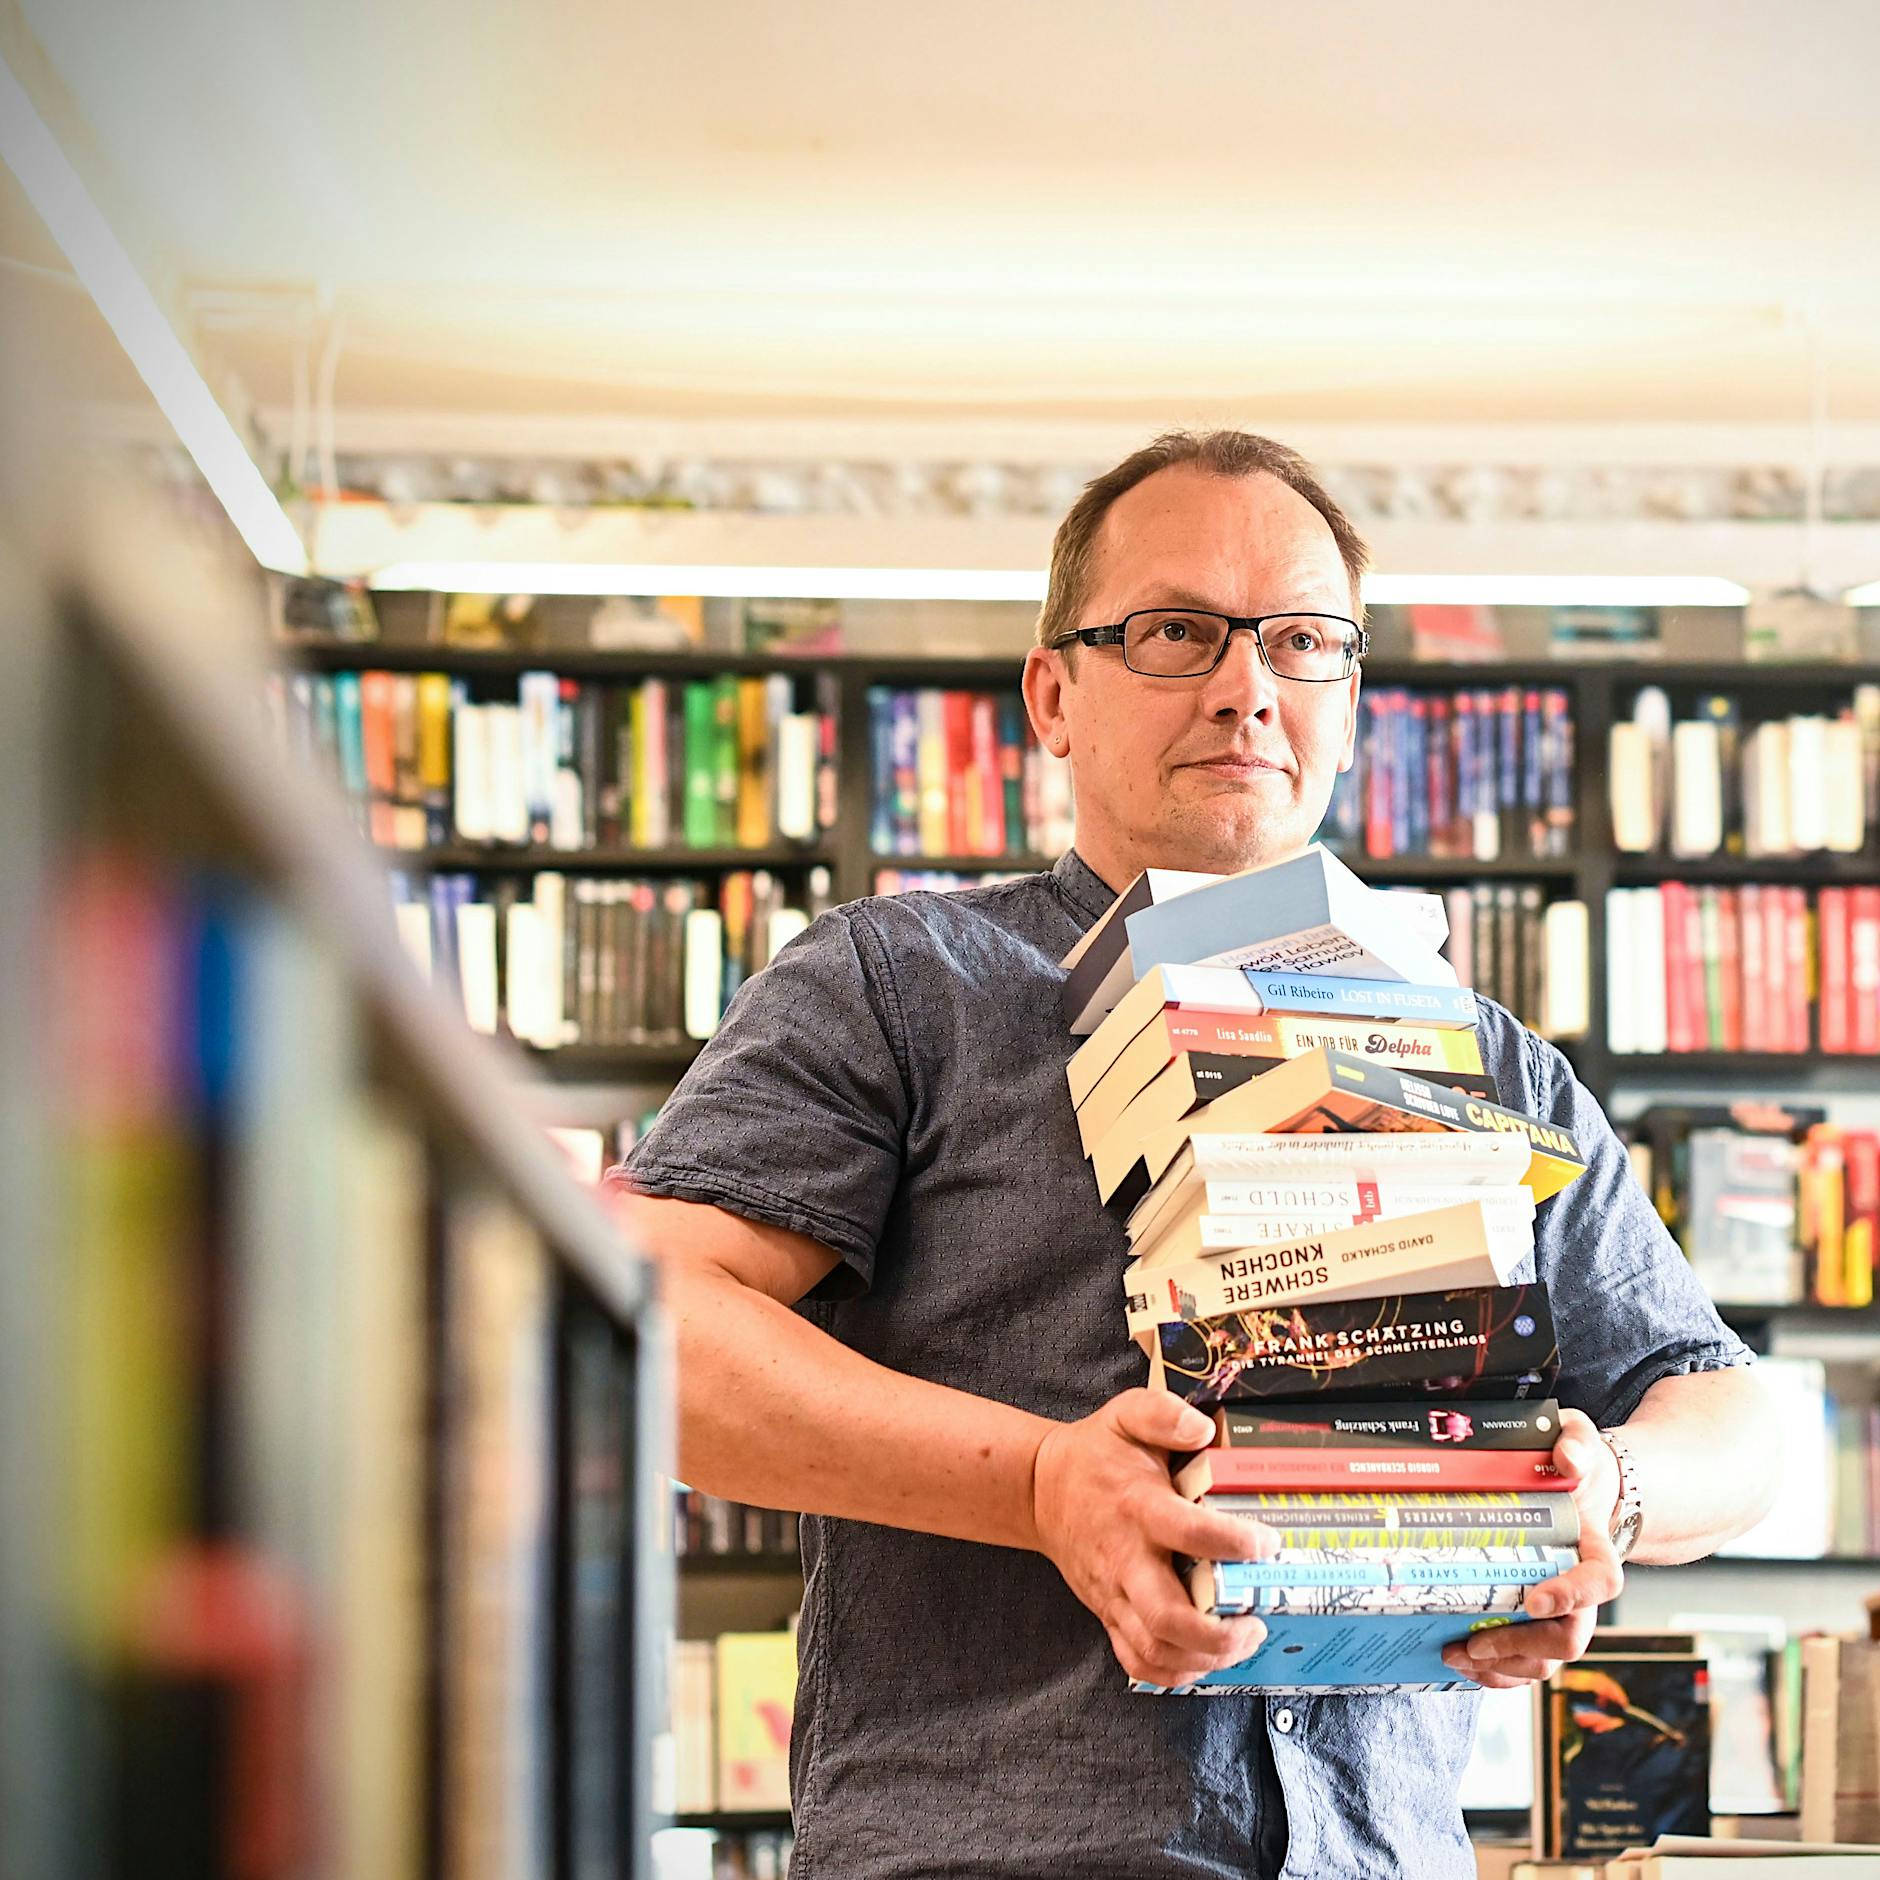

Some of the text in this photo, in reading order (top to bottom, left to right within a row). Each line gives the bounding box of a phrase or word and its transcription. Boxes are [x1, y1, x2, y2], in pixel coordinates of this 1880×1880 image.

[1283, 941, 1357, 966] Samuel
[1287, 935, 1348, 955] Leben
[1295, 947, 1365, 973] Hawley
[1268, 984, 1286, 997] Gil
[1291, 985, 1334, 1000] Ribeiro
[1340, 988, 1373, 1002] LOST
[1376, 991, 1391, 1004] IN
[1394, 993, 1442, 1007] FUSETA
[1216, 1028, 1236, 1041] Lisa
[1238, 1029, 1273, 1043] Sandlin
[1296, 1034, 1314, 1048] EIN
[1340, 1036, 1359, 1052] FÜR
[1365, 1033, 1432, 1058] Delpha
[1465, 1103, 1577, 1156] CAPITANA
[1249, 1191, 1349, 1207] SCHULD
[1366, 1190, 1376, 1208] btb
[1341, 1233, 1434, 1263] DAVID SCHALKO
[1220, 1243, 1323, 1280] KNOCHEN
[1223, 1267, 1328, 1304] SCHWERE
[1254, 1318, 1465, 1356] FRANK SCHÄTZING
[1231, 1334, 1487, 1370] DIE TYRANNEI DES SCHMETTERLINGS
[1334, 1419, 1387, 1433] Schätzing
[1388, 1421, 1420, 1433] Frank
[1482, 1420, 1527, 1430] GOLDMANN
[1349, 1462, 1406, 1473] SCERBANENCO
[1407, 1463, 1440, 1473] GIORGIO
[1262, 1511, 1331, 1524] NATÜRLICHEN
[1333, 1512, 1370, 1522] KEINES
[1403, 1511, 1453, 1523] SAYERS
[1460, 1511, 1472, 1523] L.
[1479, 1511, 1542, 1523] DOROTHY
[1242, 1567, 1547, 1581] DOROTHY L. SAYERS DISKRETE ZEUGEN
